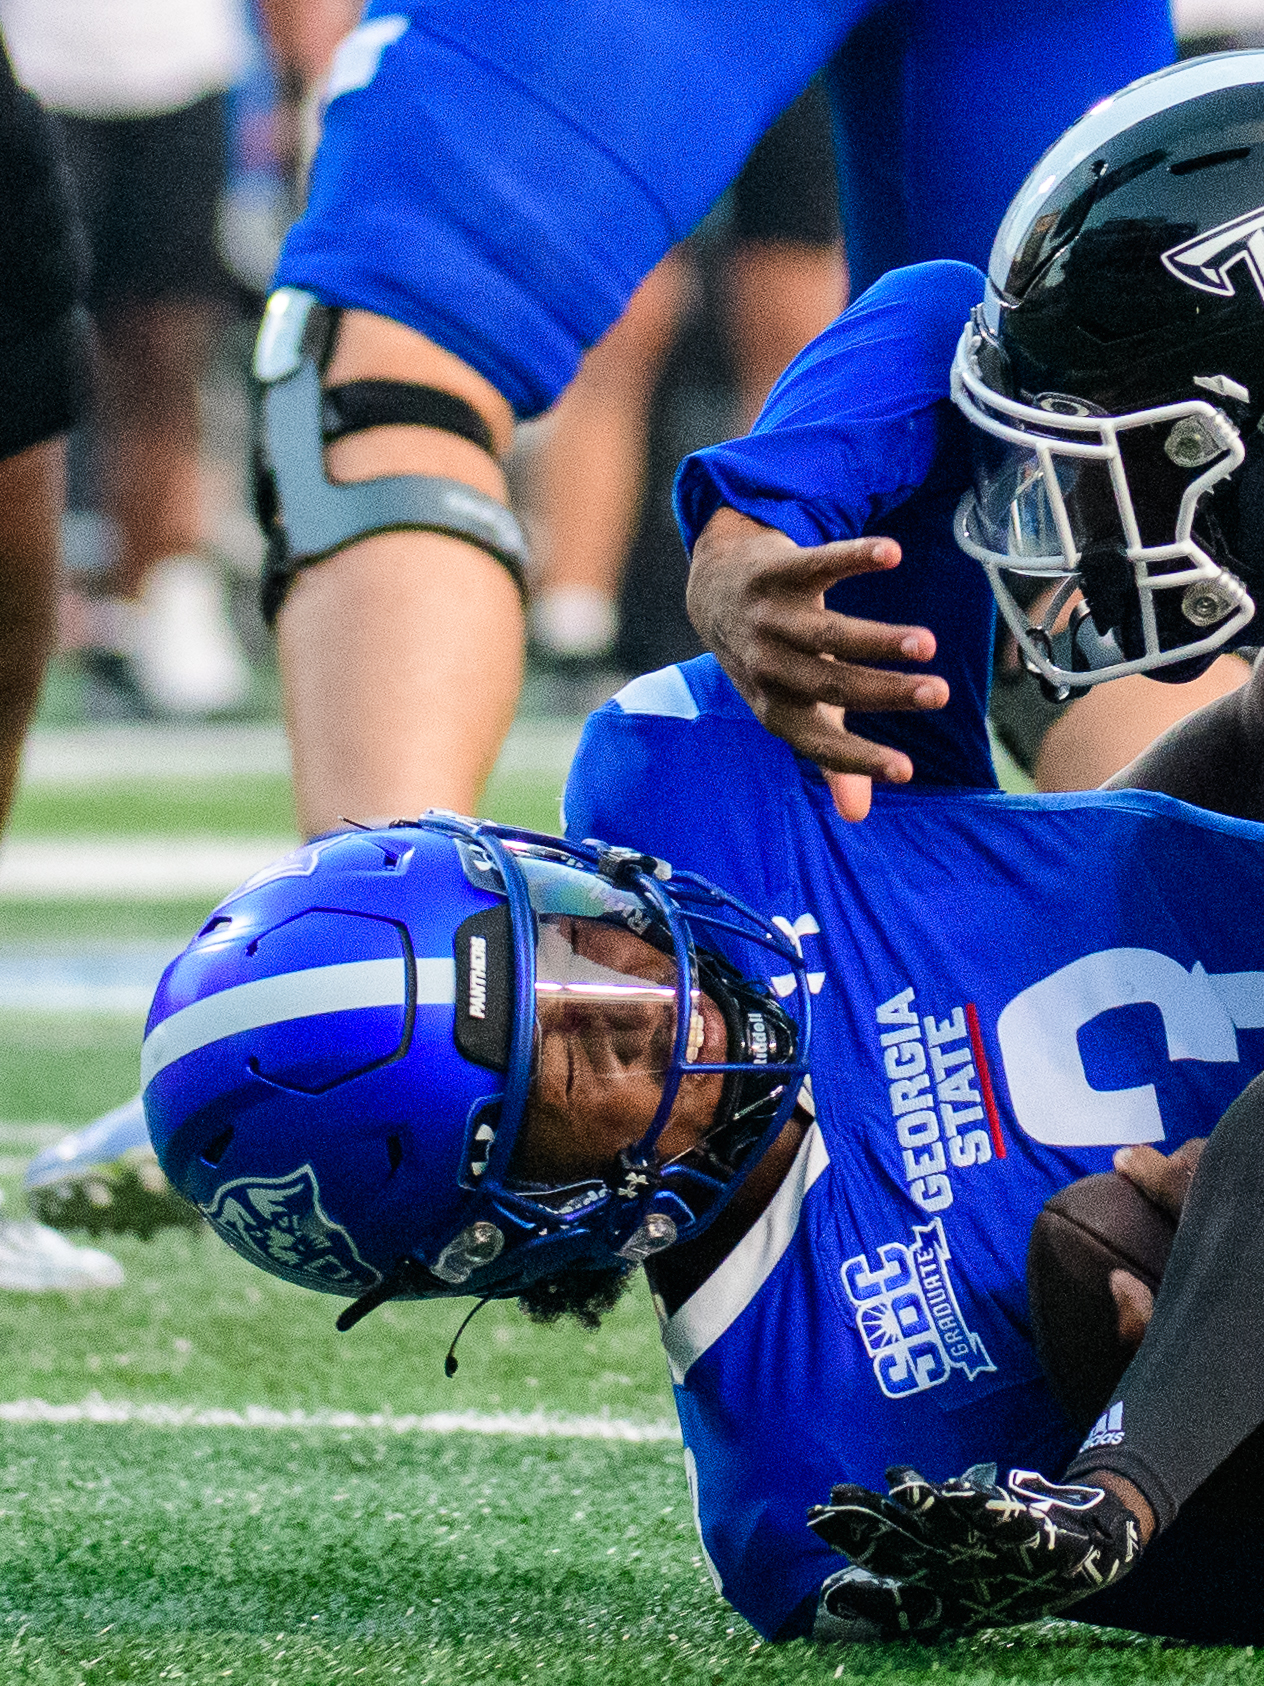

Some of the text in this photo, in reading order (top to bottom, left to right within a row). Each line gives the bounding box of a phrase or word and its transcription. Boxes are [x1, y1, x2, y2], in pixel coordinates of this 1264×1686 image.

[469, 935, 487, 1019] PANTHERS
[876, 986, 954, 1213] GEORGIA
[923, 1006, 992, 1168] STATE
[916, 1246, 969, 1357] GRADUATE
